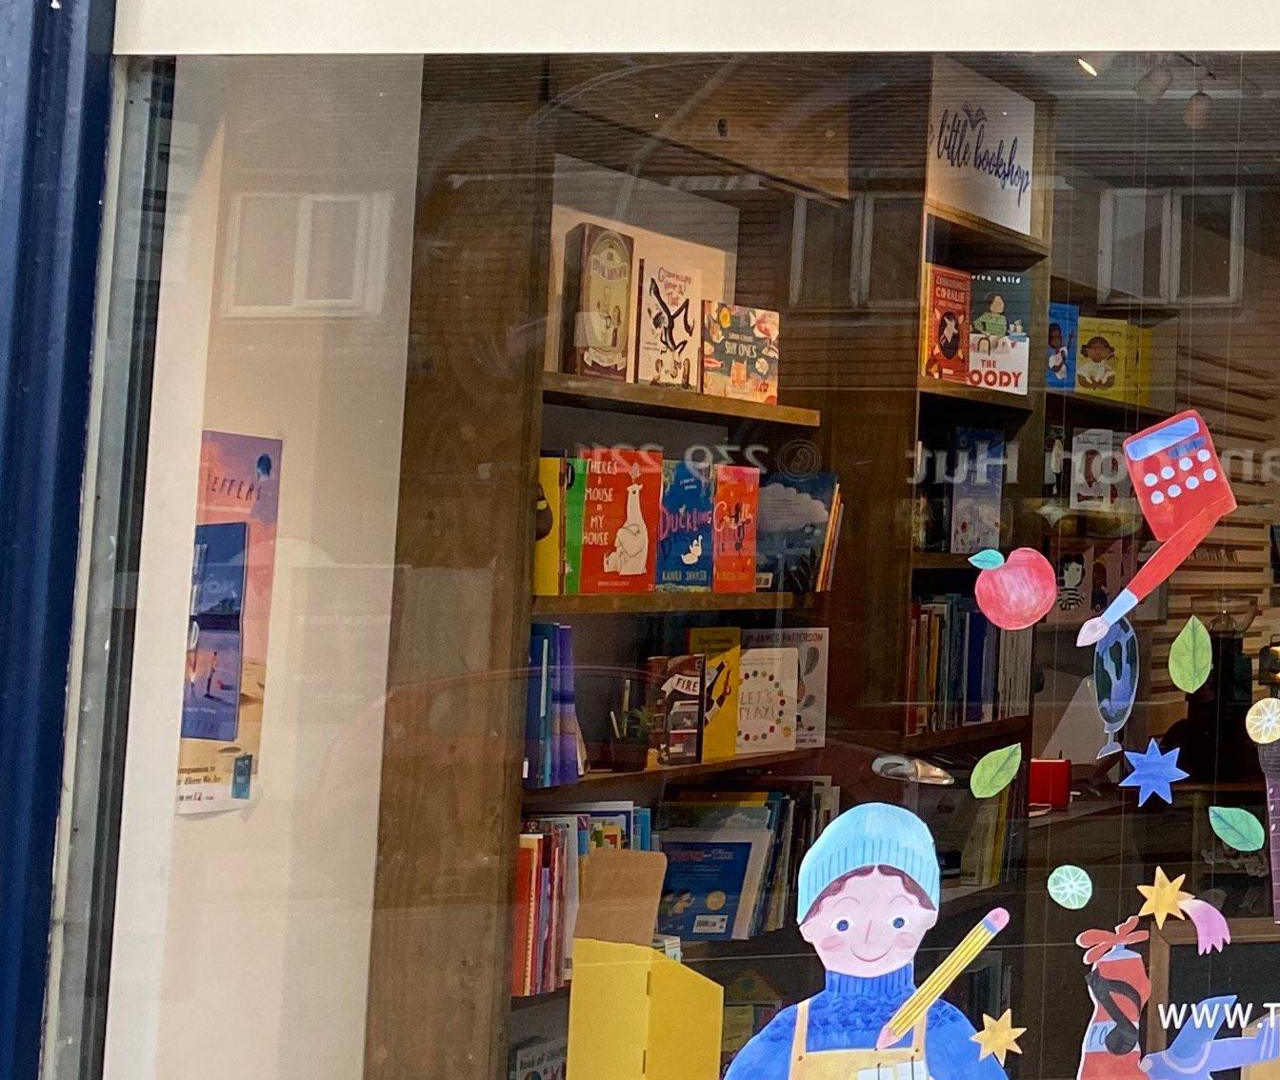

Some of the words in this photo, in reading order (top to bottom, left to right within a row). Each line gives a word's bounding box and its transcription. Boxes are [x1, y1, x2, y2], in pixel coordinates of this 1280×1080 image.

[937, 109, 971, 169] little
[972, 123, 1031, 208] bookshop
[738, 344, 757, 358] ONES
[981, 359, 997, 369] THE
[968, 369, 1023, 388] OODY
[585, 487, 614, 502] MOUSE
[590, 515, 605, 529] MY
[583, 531, 609, 546] HOUSE
[782, 632, 824, 643] PATTERSON
[675, 676, 699, 693] FIRE
